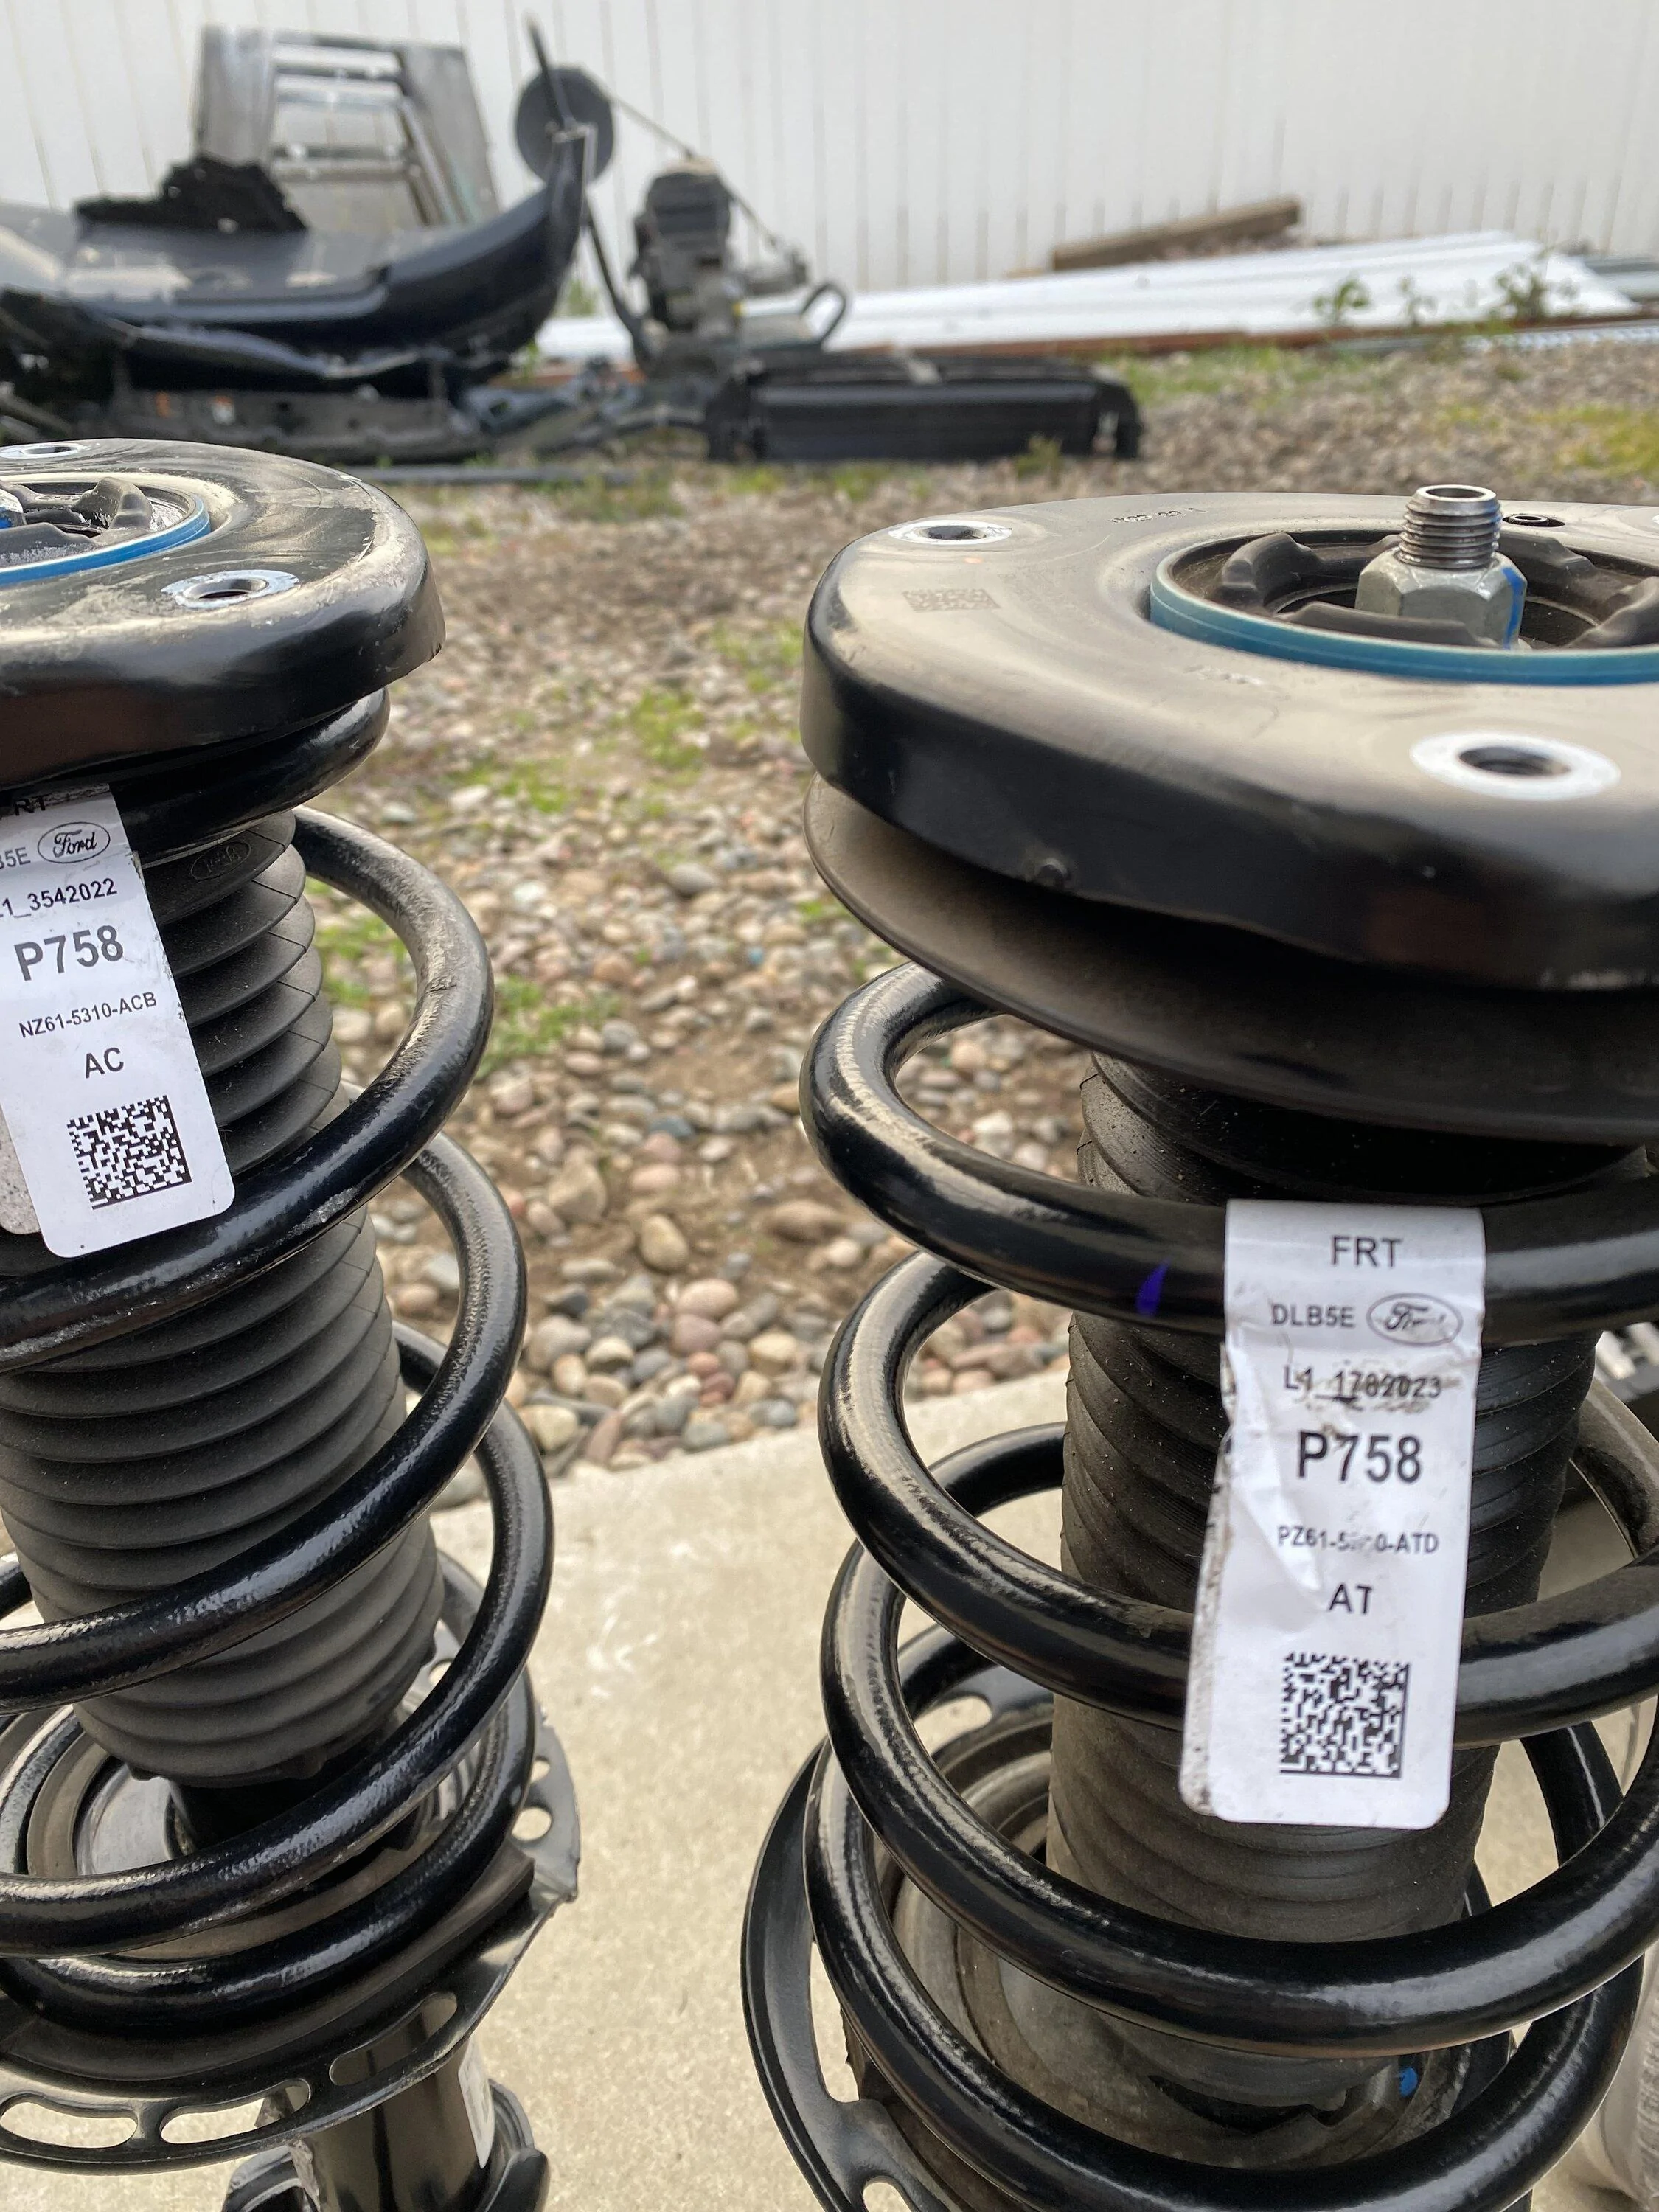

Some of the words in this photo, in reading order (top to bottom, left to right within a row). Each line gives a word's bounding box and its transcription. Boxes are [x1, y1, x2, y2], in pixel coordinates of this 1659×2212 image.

[52, 829, 98, 858] Ford
[0, 877, 118, 918] 1_3542022
[13, 925, 124, 981] P758
[18, 992, 157, 1038] NZ61-5310-ACB
[85, 1047, 125, 1079] AC
[1332, 1235, 1403, 1268] FRT
[1271, 1304, 1354, 1328] DLB5E
[1298, 1430, 1422, 1483] P758
[1328, 1583, 1373, 1615] AT
